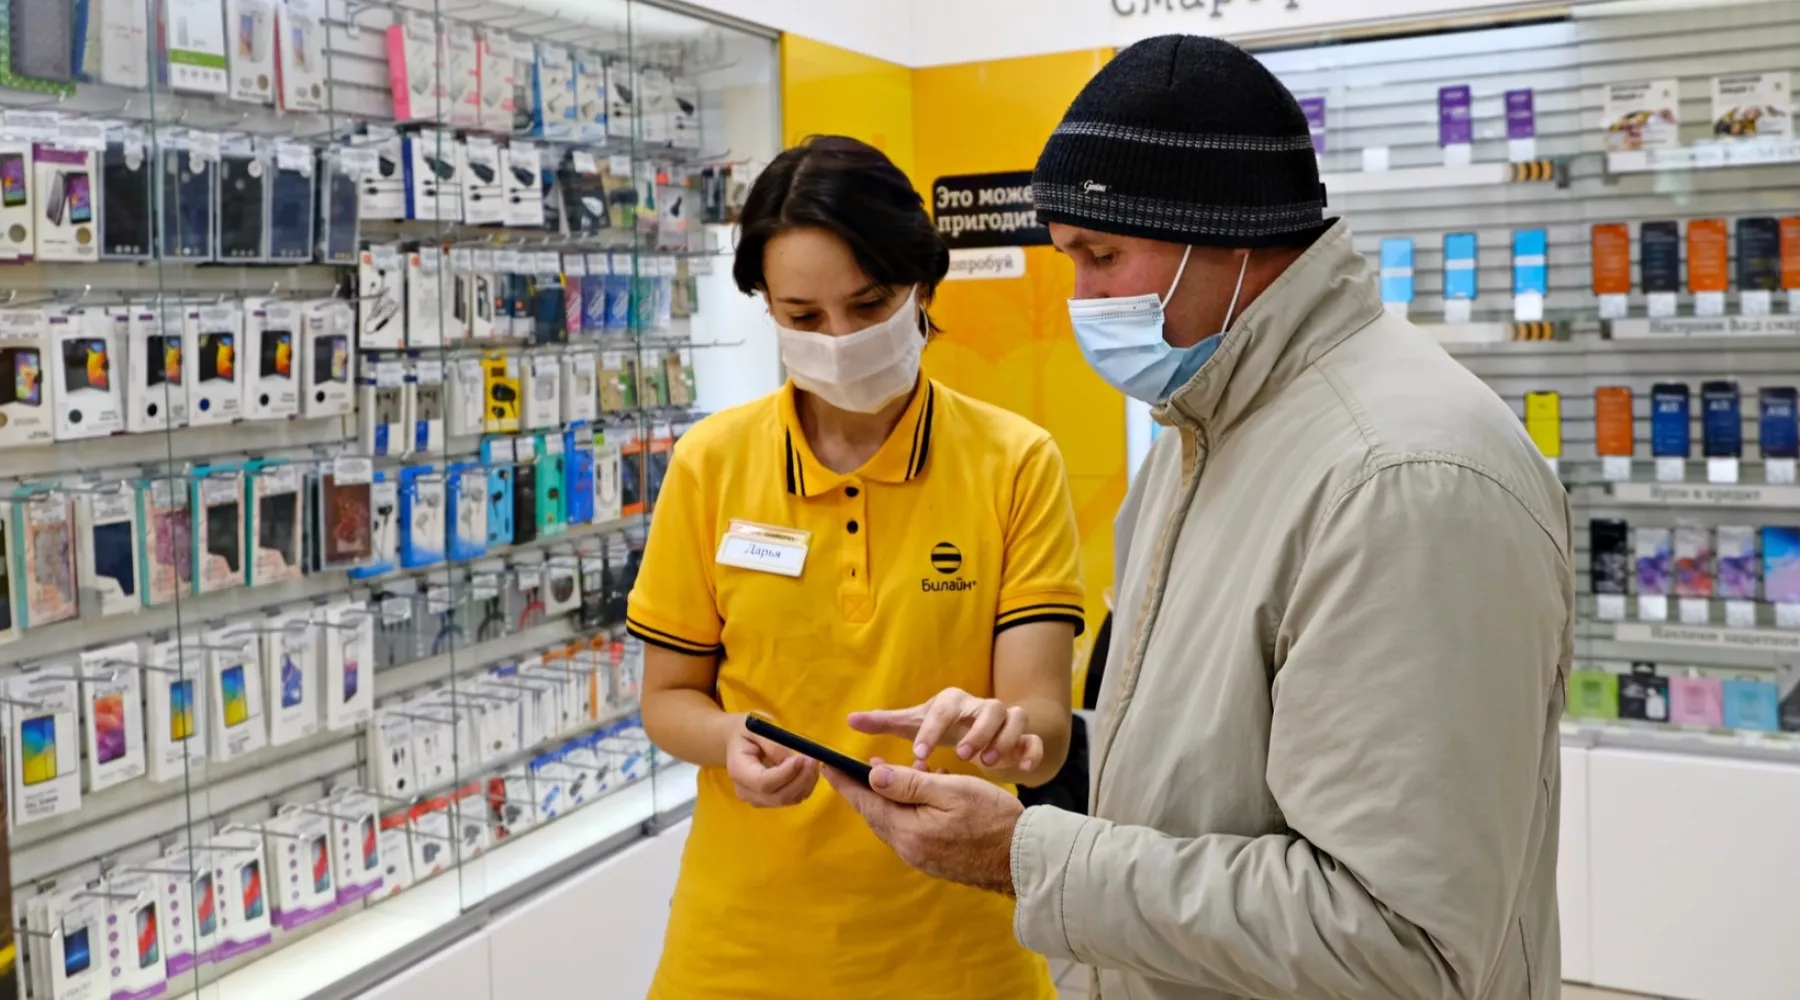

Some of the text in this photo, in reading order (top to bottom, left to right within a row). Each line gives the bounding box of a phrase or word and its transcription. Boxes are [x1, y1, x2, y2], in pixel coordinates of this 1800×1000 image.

[936, 186, 973, 209] Это
[937, 210, 1047, 238] пригодит
[744, 543, 781, 559] Дарья
